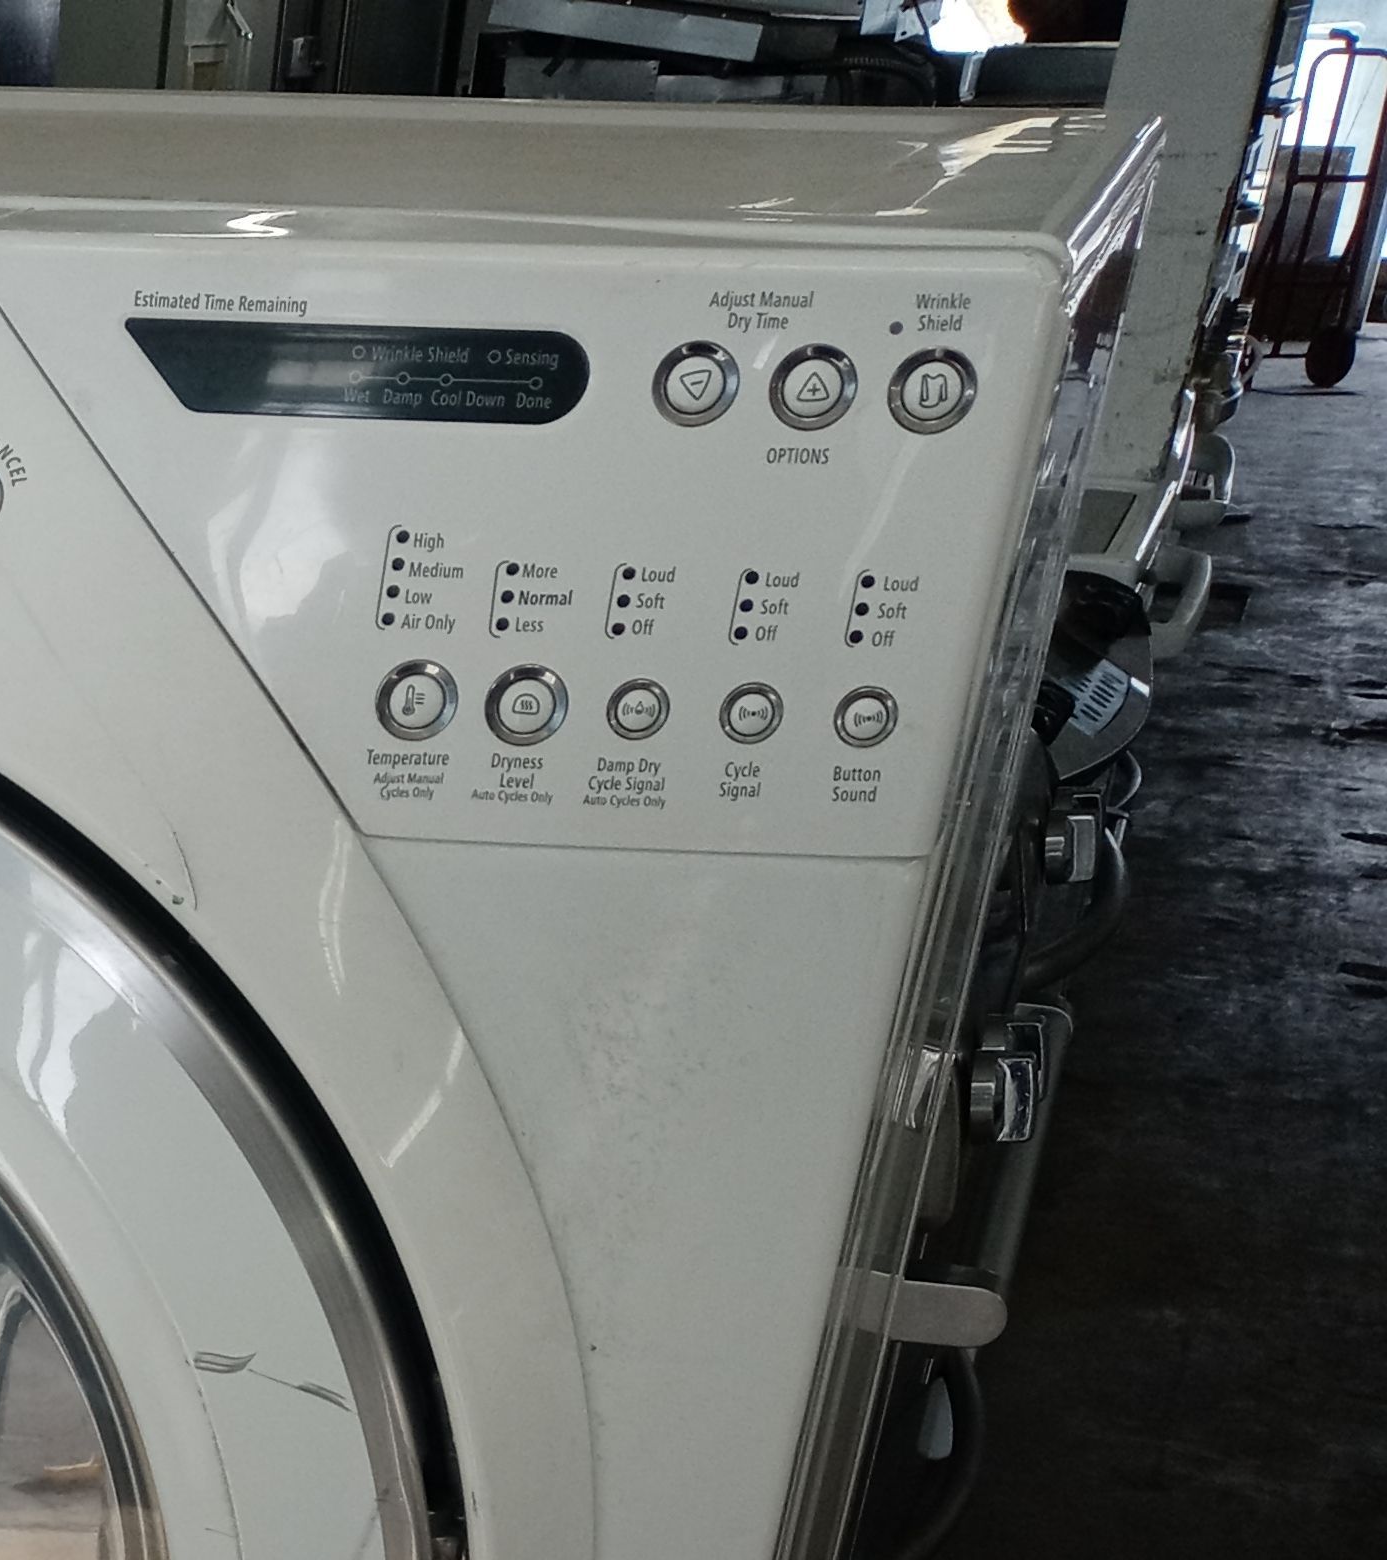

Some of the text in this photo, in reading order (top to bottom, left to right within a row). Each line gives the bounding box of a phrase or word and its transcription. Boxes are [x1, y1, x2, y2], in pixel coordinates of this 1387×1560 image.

[134, 290, 308, 317] Estimated Time Remaining
[709, 291, 815, 311] Adjust Manual
[915, 293, 972, 310] Wrinkle
[727, 312, 789, 333] Dry Time
[917, 315, 963, 332] Shield
[371, 345, 471, 364] Wrinkle Shield
[505, 348, 560, 371] Sensing
[344, 388, 552, 409] Wet Damp Cool Down Done
[766, 447, 830, 465] OPTIONS
[413, 532, 444, 552] High
[408, 561, 464, 579] Medium
[522, 563, 558, 579] More
[641, 566, 676, 583] Loud
[765, 571, 800, 588] Loud
[883, 576, 919, 592] Loud
[404, 588, 433, 605] Low
[517, 589, 573, 606] Normal
[635, 593, 665, 610] Soft
[760, 598, 789, 615] Soft
[877, 602, 907, 619] Soft
[400, 614, 456, 634] Air Only
[515, 617, 544, 633] Less
[631, 619, 655, 636] Off
[755, 625, 779, 641] Off
[871, 630, 896, 647] Off
[366, 748, 450, 768] Temperature
[490, 753, 544, 772] Dryness
[597, 757, 661, 776] Damp Dry
[373, 772, 444, 787] Adjust Manual
[724, 761, 760, 782] Cycle
[832, 766, 881, 783] Button
[499, 774, 534, 789] Level
[588, 776, 665, 794] Cycle Signal
[380, 785, 434, 801] Cycles Only
[471, 789, 554, 805] Auto Cycles Only
[718, 782, 761, 802] Signal
[831, 786, 877, 803] Sound
[583, 795, 666, 809] Auto Cycles Only
